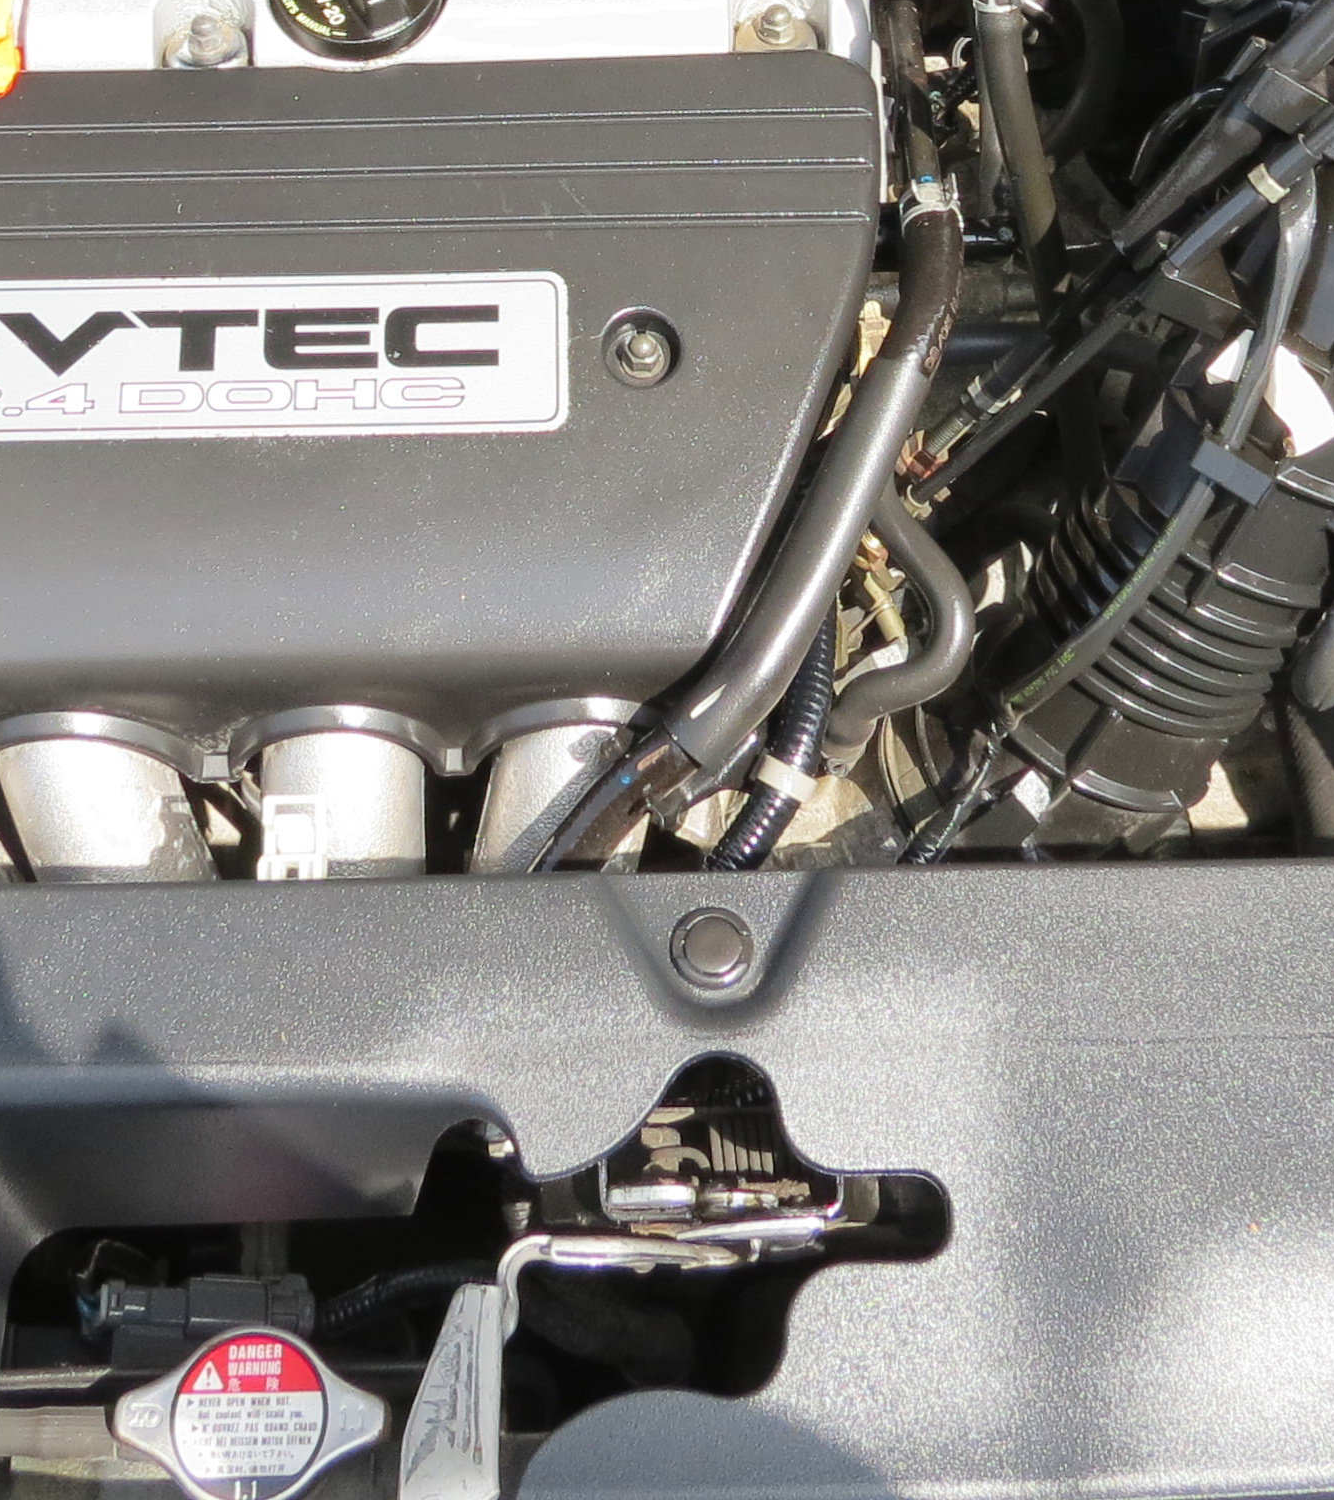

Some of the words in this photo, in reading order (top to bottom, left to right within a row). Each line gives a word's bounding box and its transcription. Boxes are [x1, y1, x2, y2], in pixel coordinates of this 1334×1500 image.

[295, 12, 331, 37] MANUAL
[119, 377, 466, 413] DOHC
[228, 1344, 282, 1360] DANGER
[228, 1360, 282, 1376] WARNUNG
[198, 1397, 221, 1407] NEVER
[226, 1396, 245, 1407] OPEN
[251, 1396, 270, 1406] WHEN
[244, 1423, 258, 1432] PAS
[234, 1480, 258, 1499] 1.1
